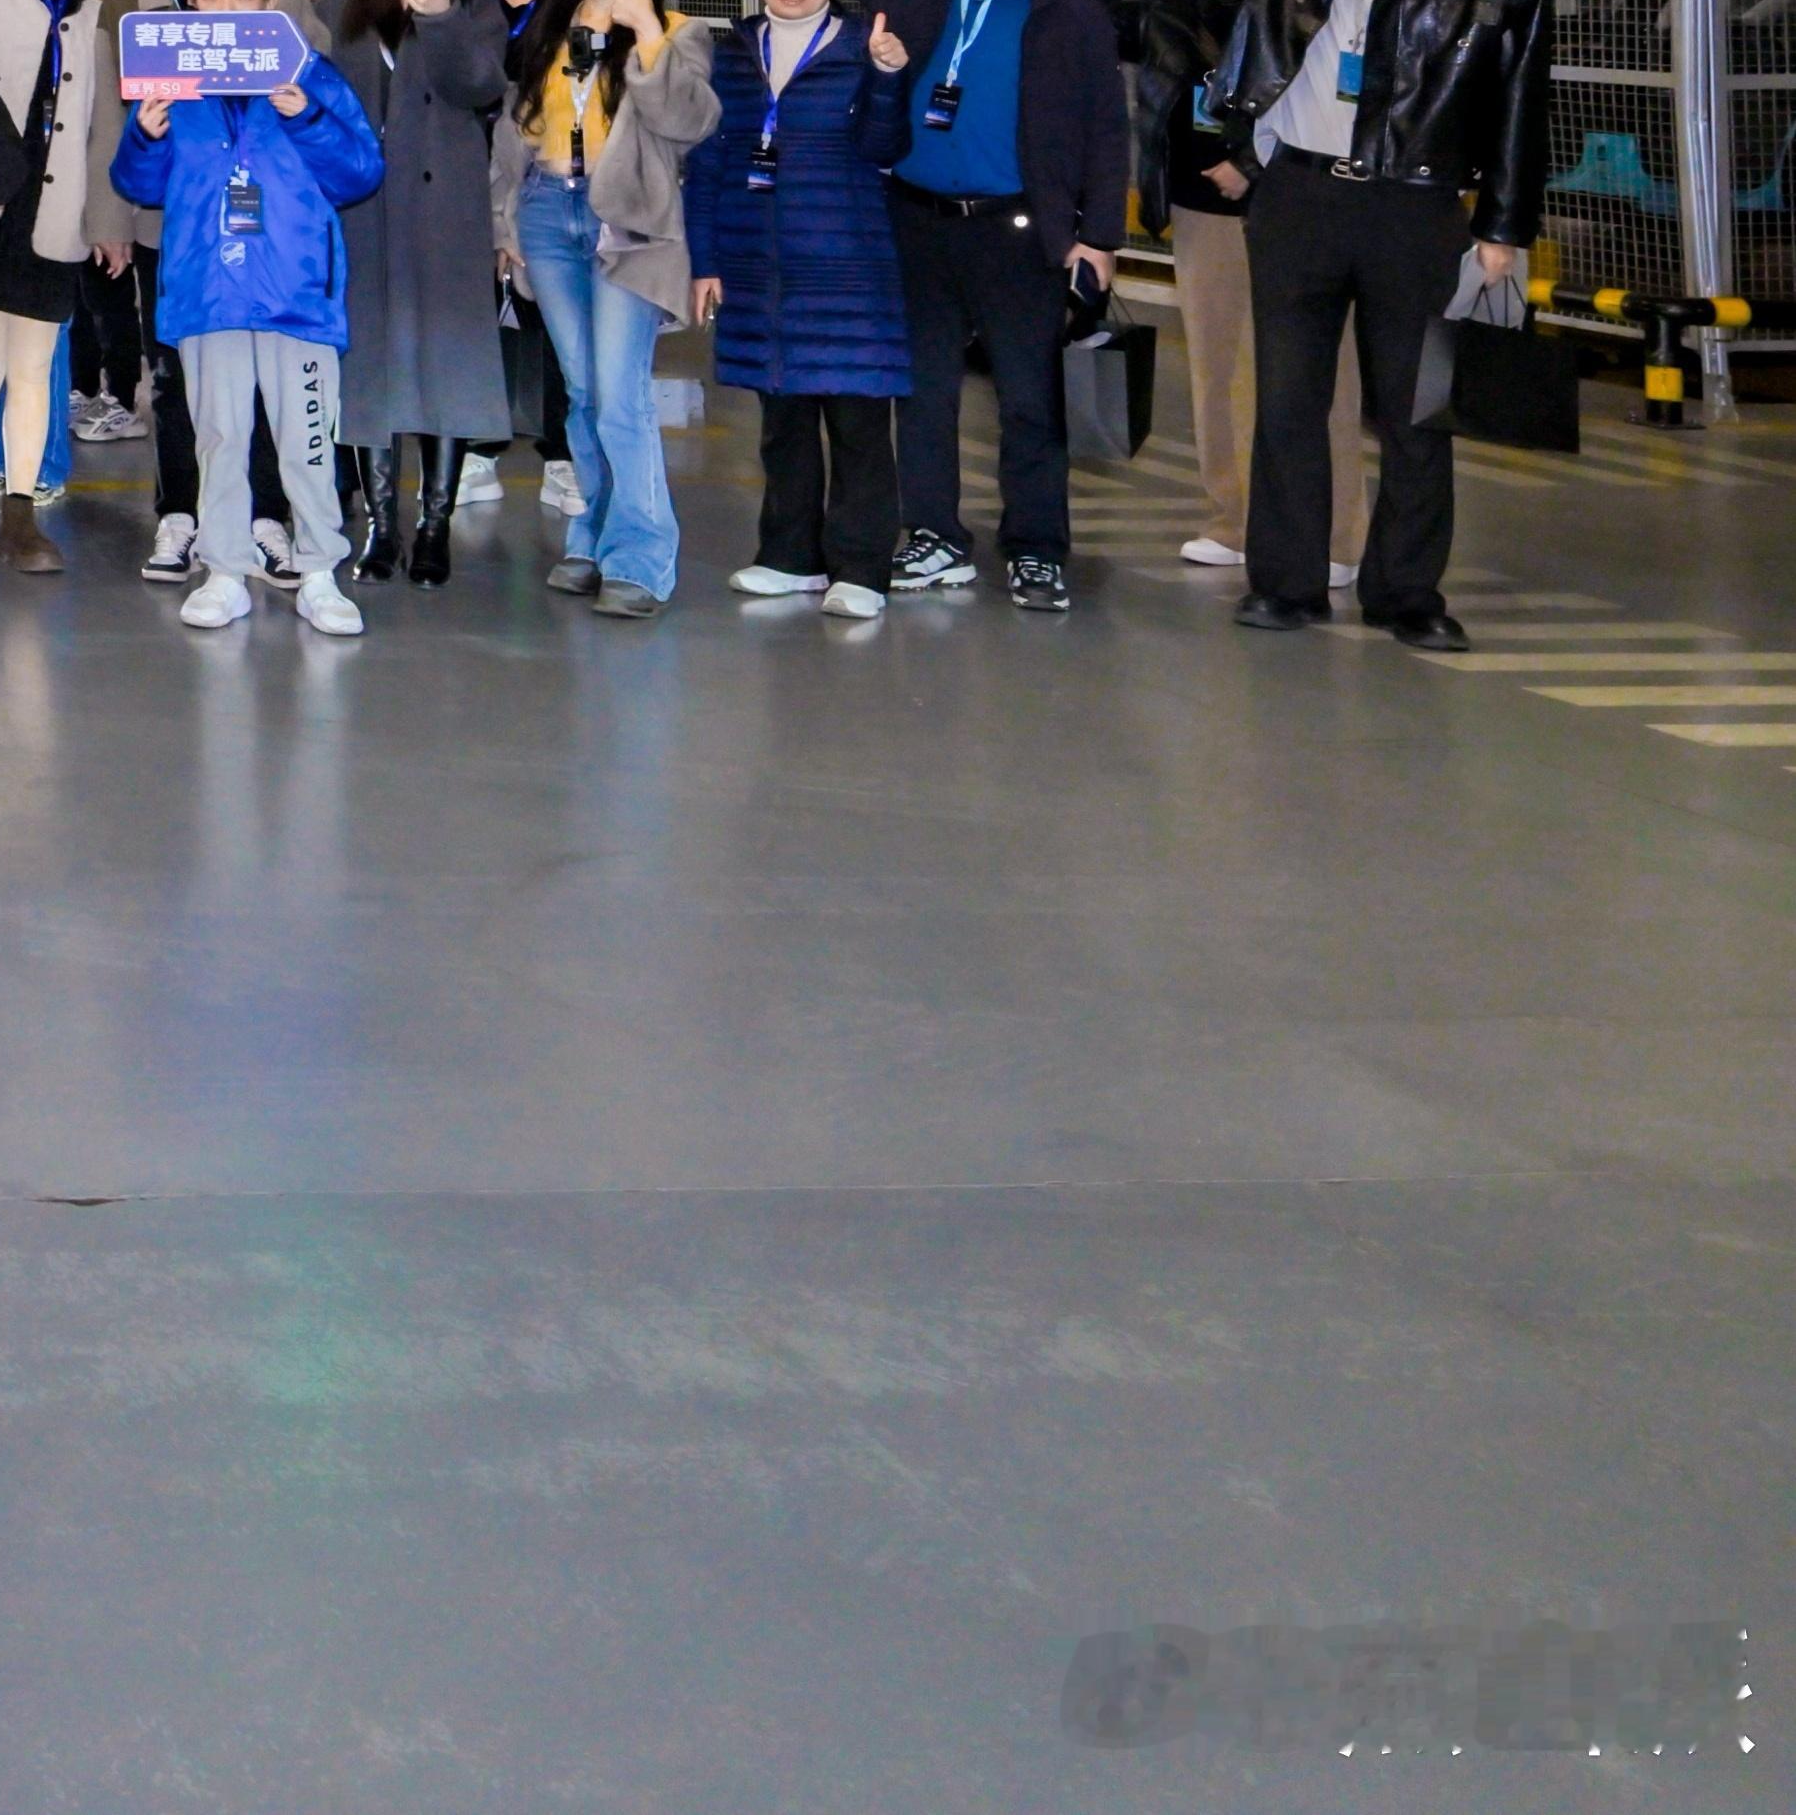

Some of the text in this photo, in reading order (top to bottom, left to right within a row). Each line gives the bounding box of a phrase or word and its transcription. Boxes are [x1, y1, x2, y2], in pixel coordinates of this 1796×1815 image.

[135, 22, 237, 47] 奢享专属
[177, 48, 280, 72] 座驾气派
[127, 82, 181, 95] 享界 S9
[303, 360, 323, 466] ADIDAS
